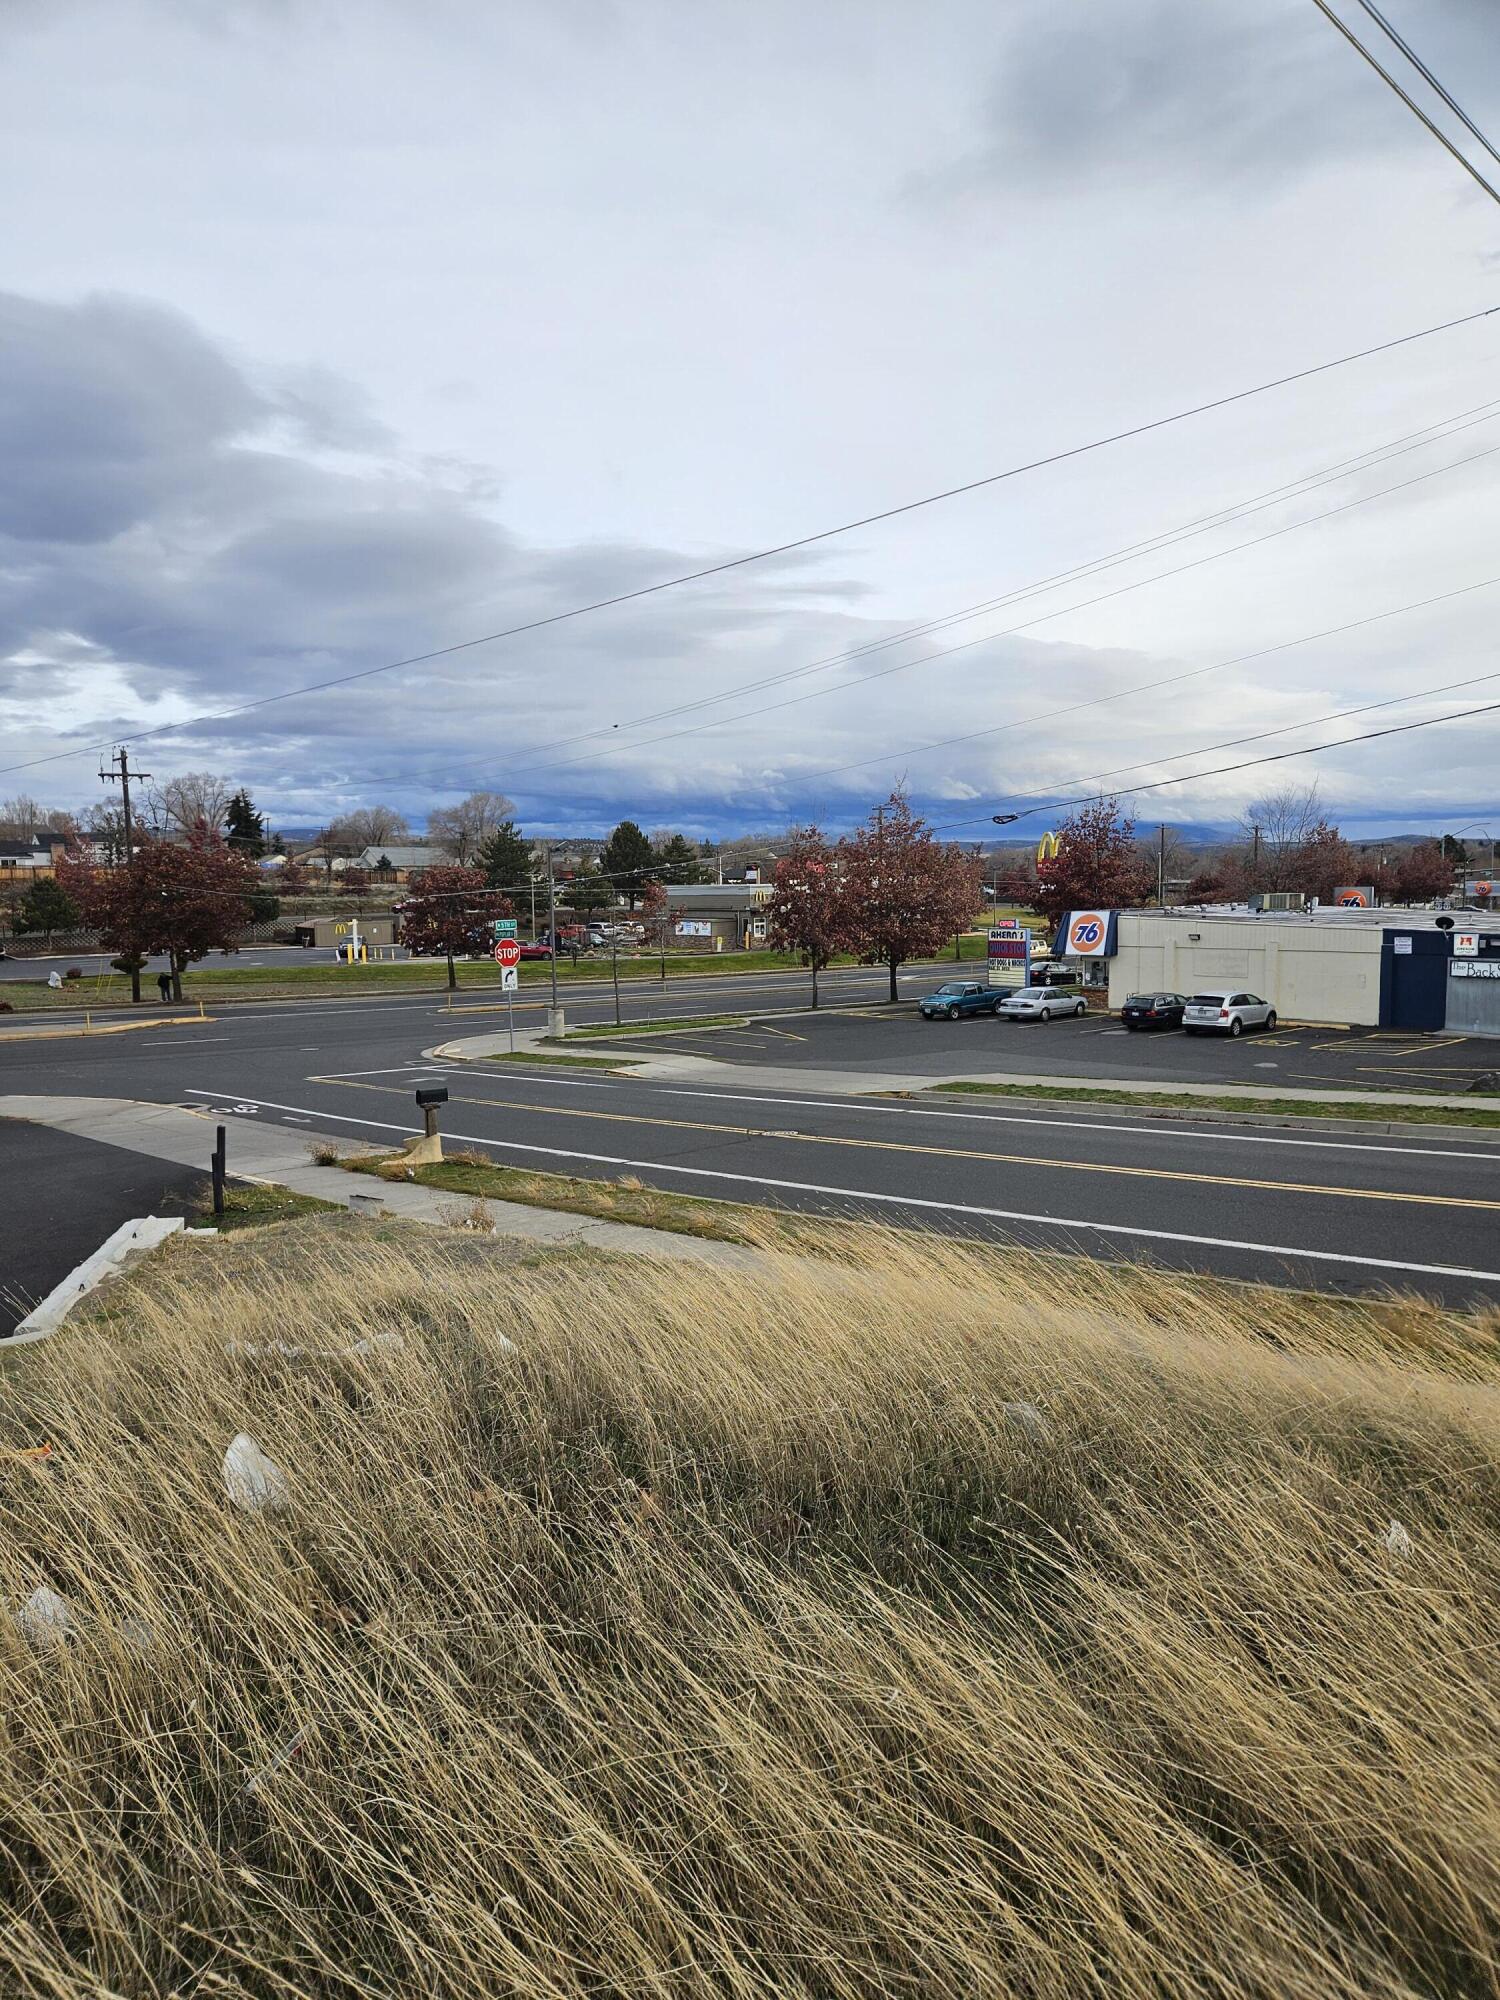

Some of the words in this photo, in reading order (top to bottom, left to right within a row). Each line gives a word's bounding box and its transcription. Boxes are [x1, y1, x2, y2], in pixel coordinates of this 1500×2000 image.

[1341, 896, 1361, 907] 76
[991, 931, 1024, 939] AHERN'S
[1073, 922, 1100, 943] 76
[497, 948, 518, 959] STOP
[1009, 943, 1026, 954] STOP
[1452, 961, 1466, 970] The
[1467, 962, 1495, 977] Back
